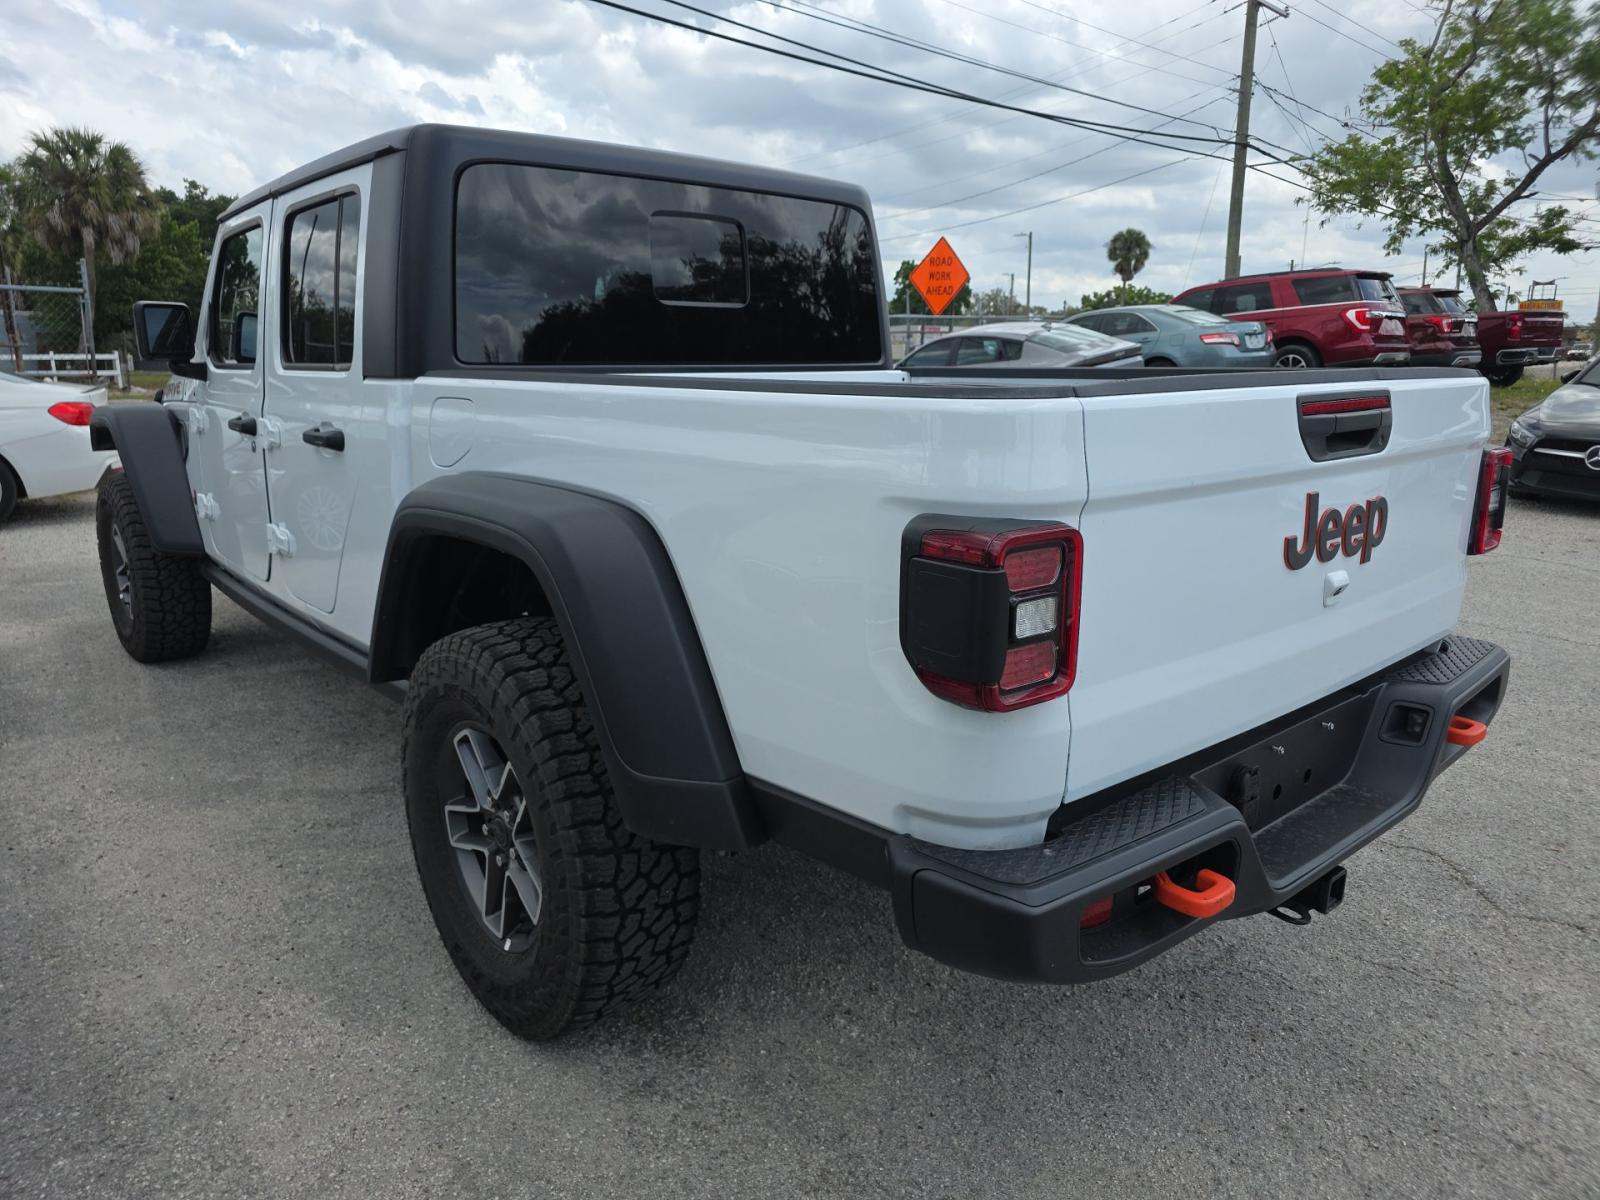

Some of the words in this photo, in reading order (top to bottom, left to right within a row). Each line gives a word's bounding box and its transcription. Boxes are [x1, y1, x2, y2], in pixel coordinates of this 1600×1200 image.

[929, 257, 953, 266] ROAD
[929, 271, 951, 282] WORK
[926, 285, 953, 295] AHEAD
[1283, 491, 1389, 571] Jeep
